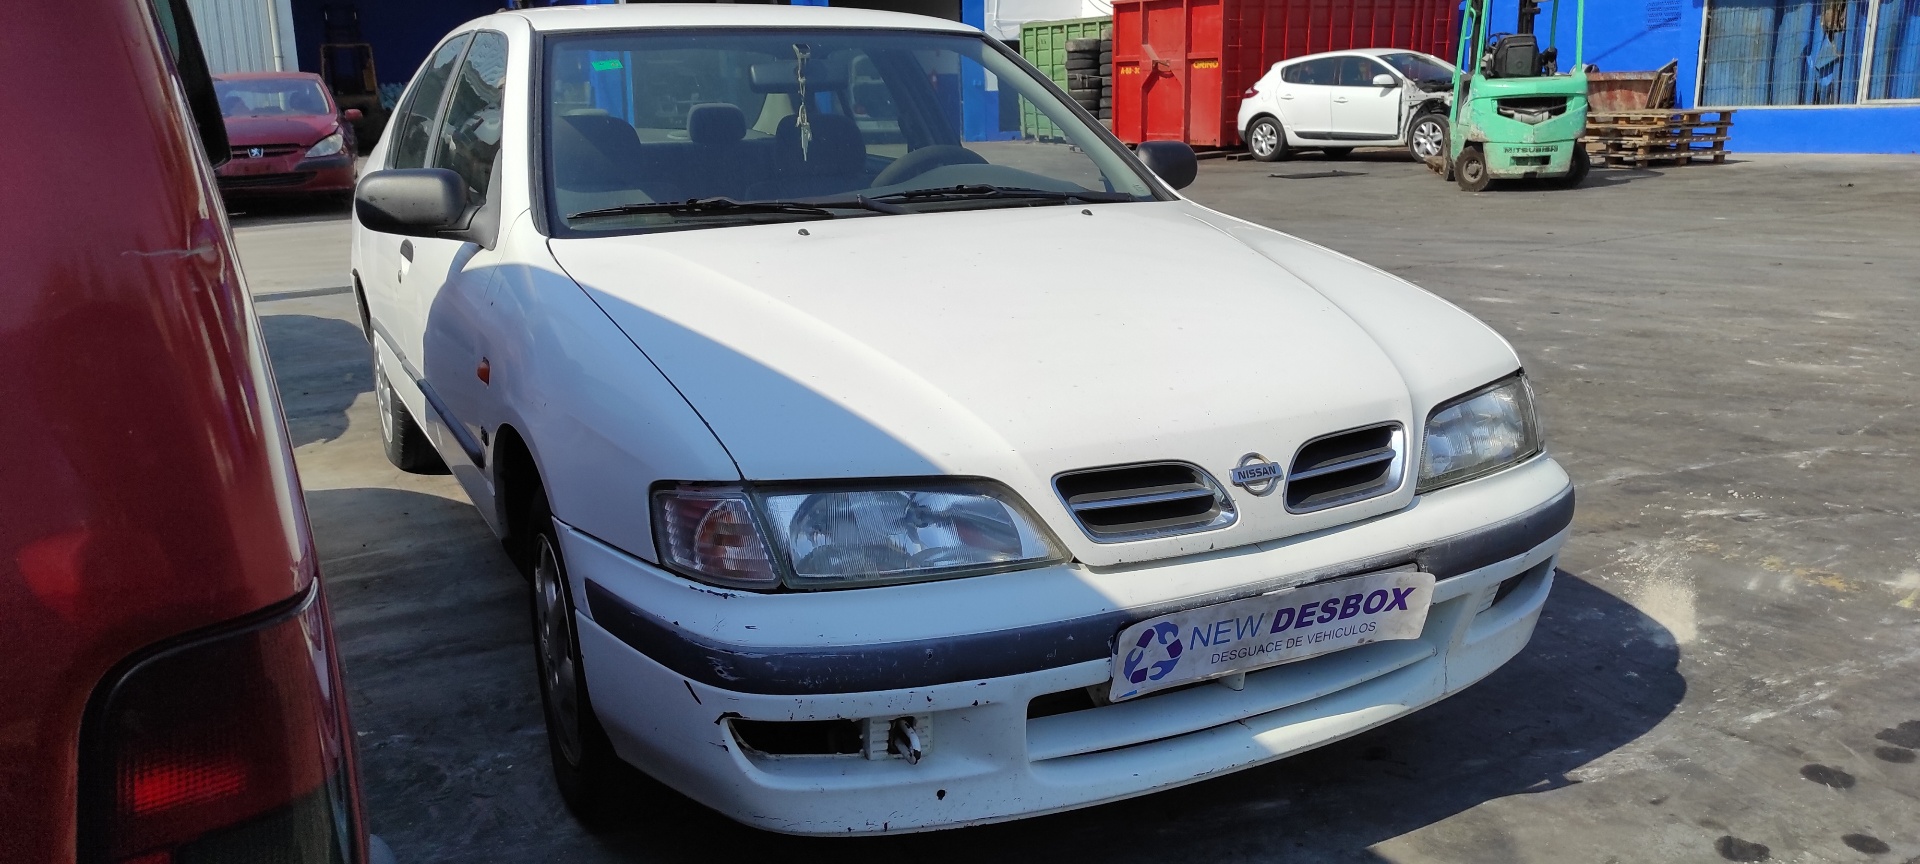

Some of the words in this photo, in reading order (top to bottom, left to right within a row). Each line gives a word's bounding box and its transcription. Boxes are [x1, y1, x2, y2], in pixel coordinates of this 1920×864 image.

[1237, 466, 1276, 480] NISSAN
[1189, 612, 1265, 650] NEW
[1269, 587, 1417, 634] DESBOX
[1211, 640, 1283, 664] DESGUACE
[1286, 636, 1303, 649] DE
[1307, 621, 1377, 644] VEHICULOS
